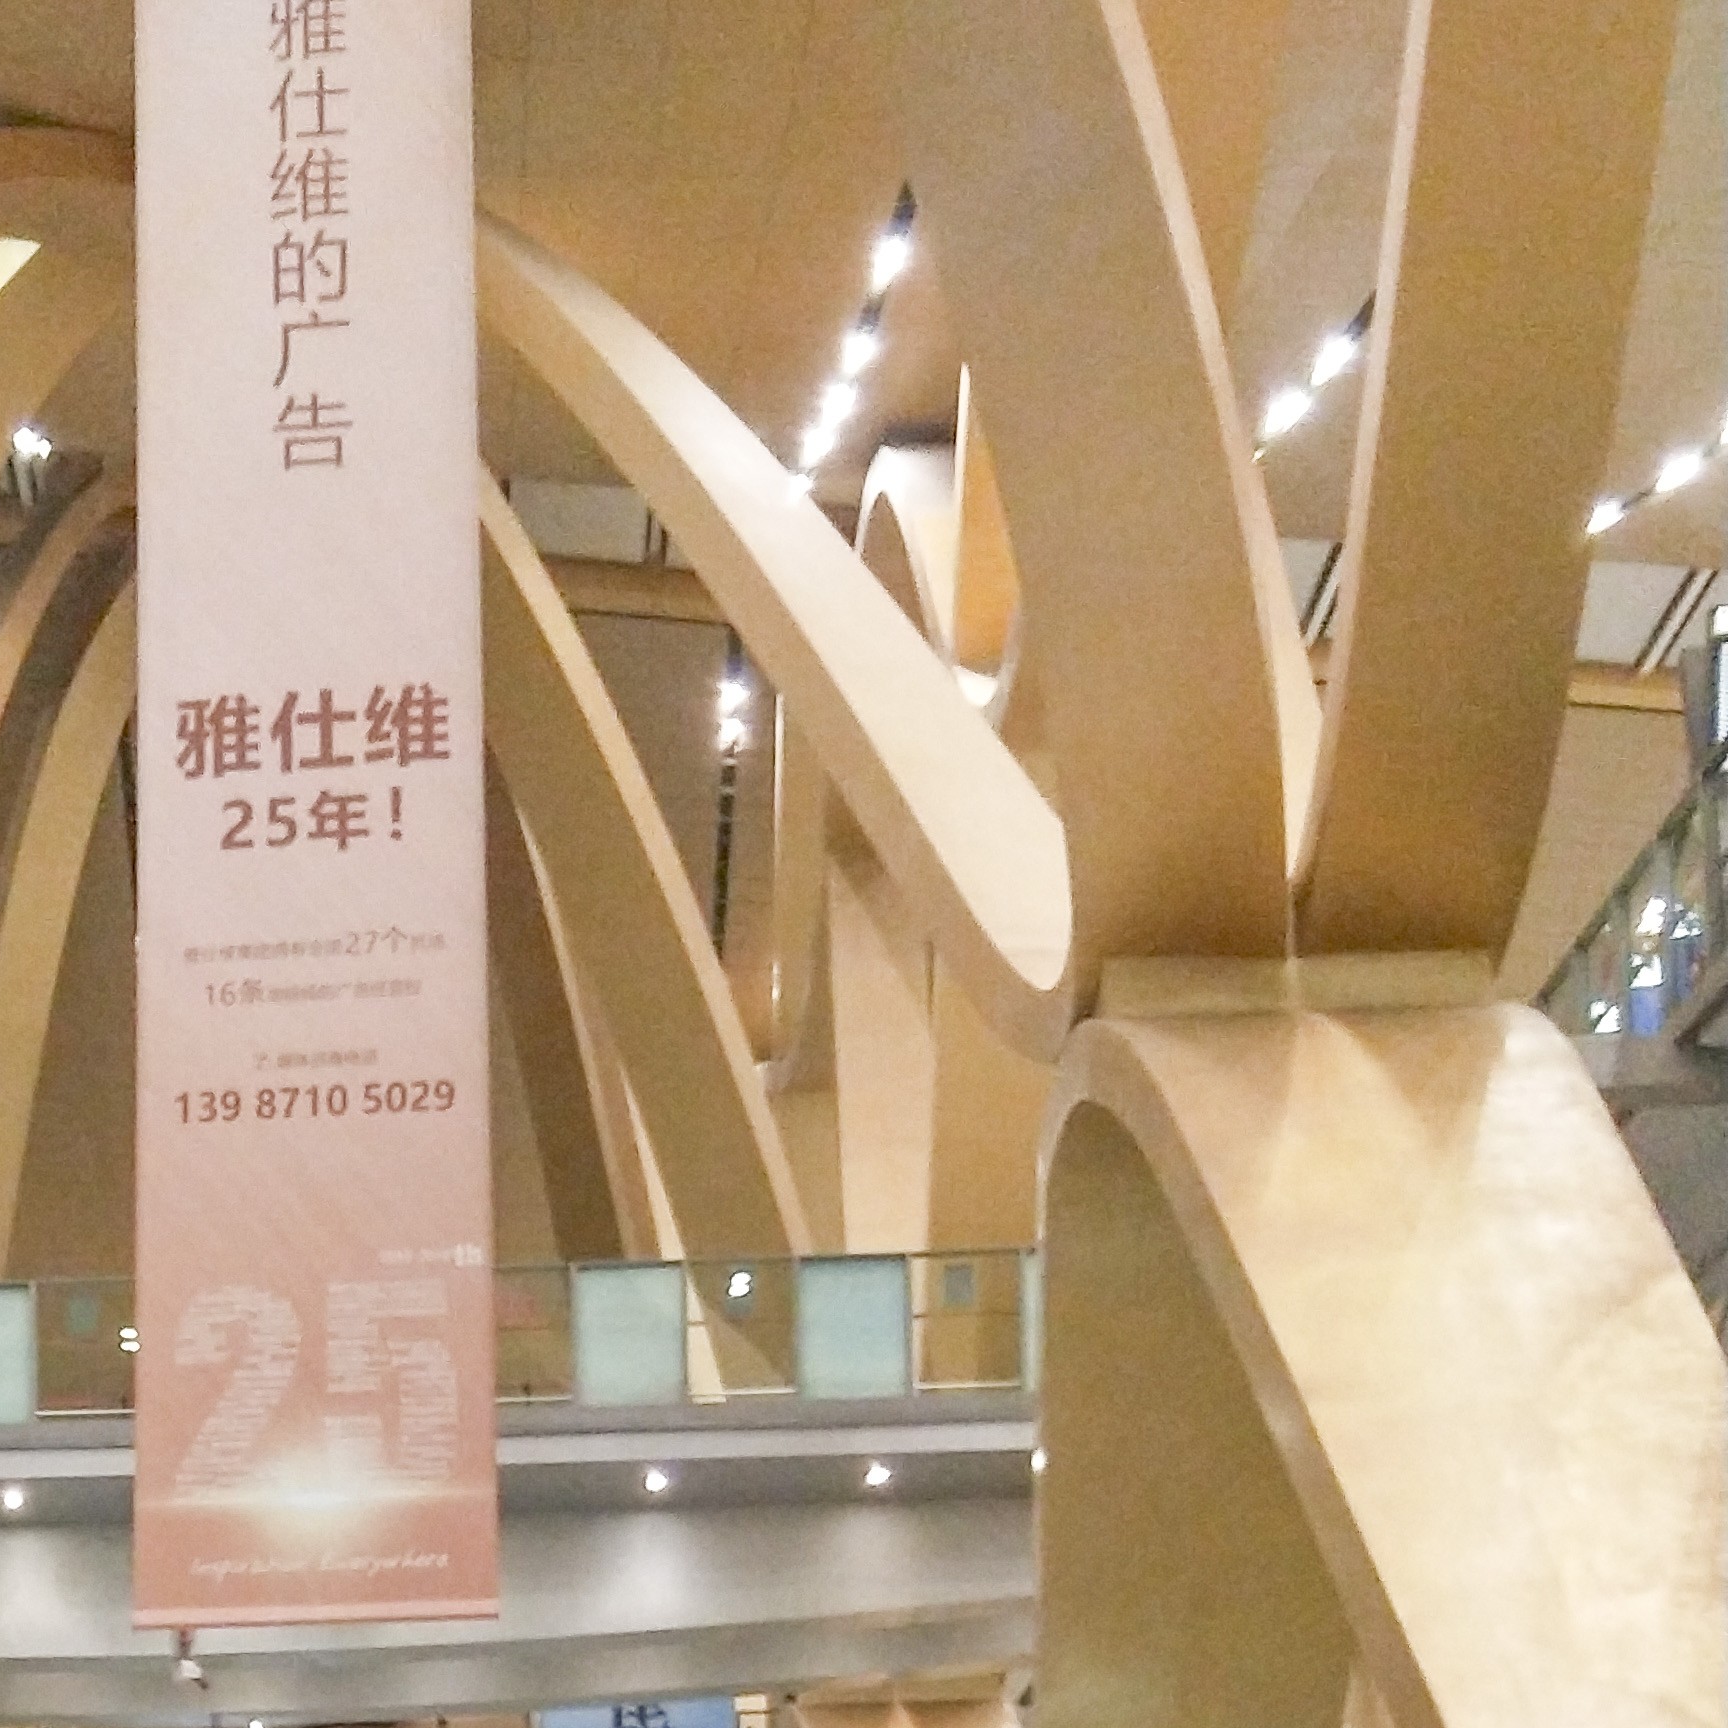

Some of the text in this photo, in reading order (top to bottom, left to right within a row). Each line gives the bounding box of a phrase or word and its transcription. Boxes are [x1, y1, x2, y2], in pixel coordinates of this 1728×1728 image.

[270, 0, 354, 471] 雅仕维的广告
[175, 681, 450, 779] 雅仕维
[219, 785, 404, 852] 25年！
[174, 1078, 457, 1124] 139 8710 5029
